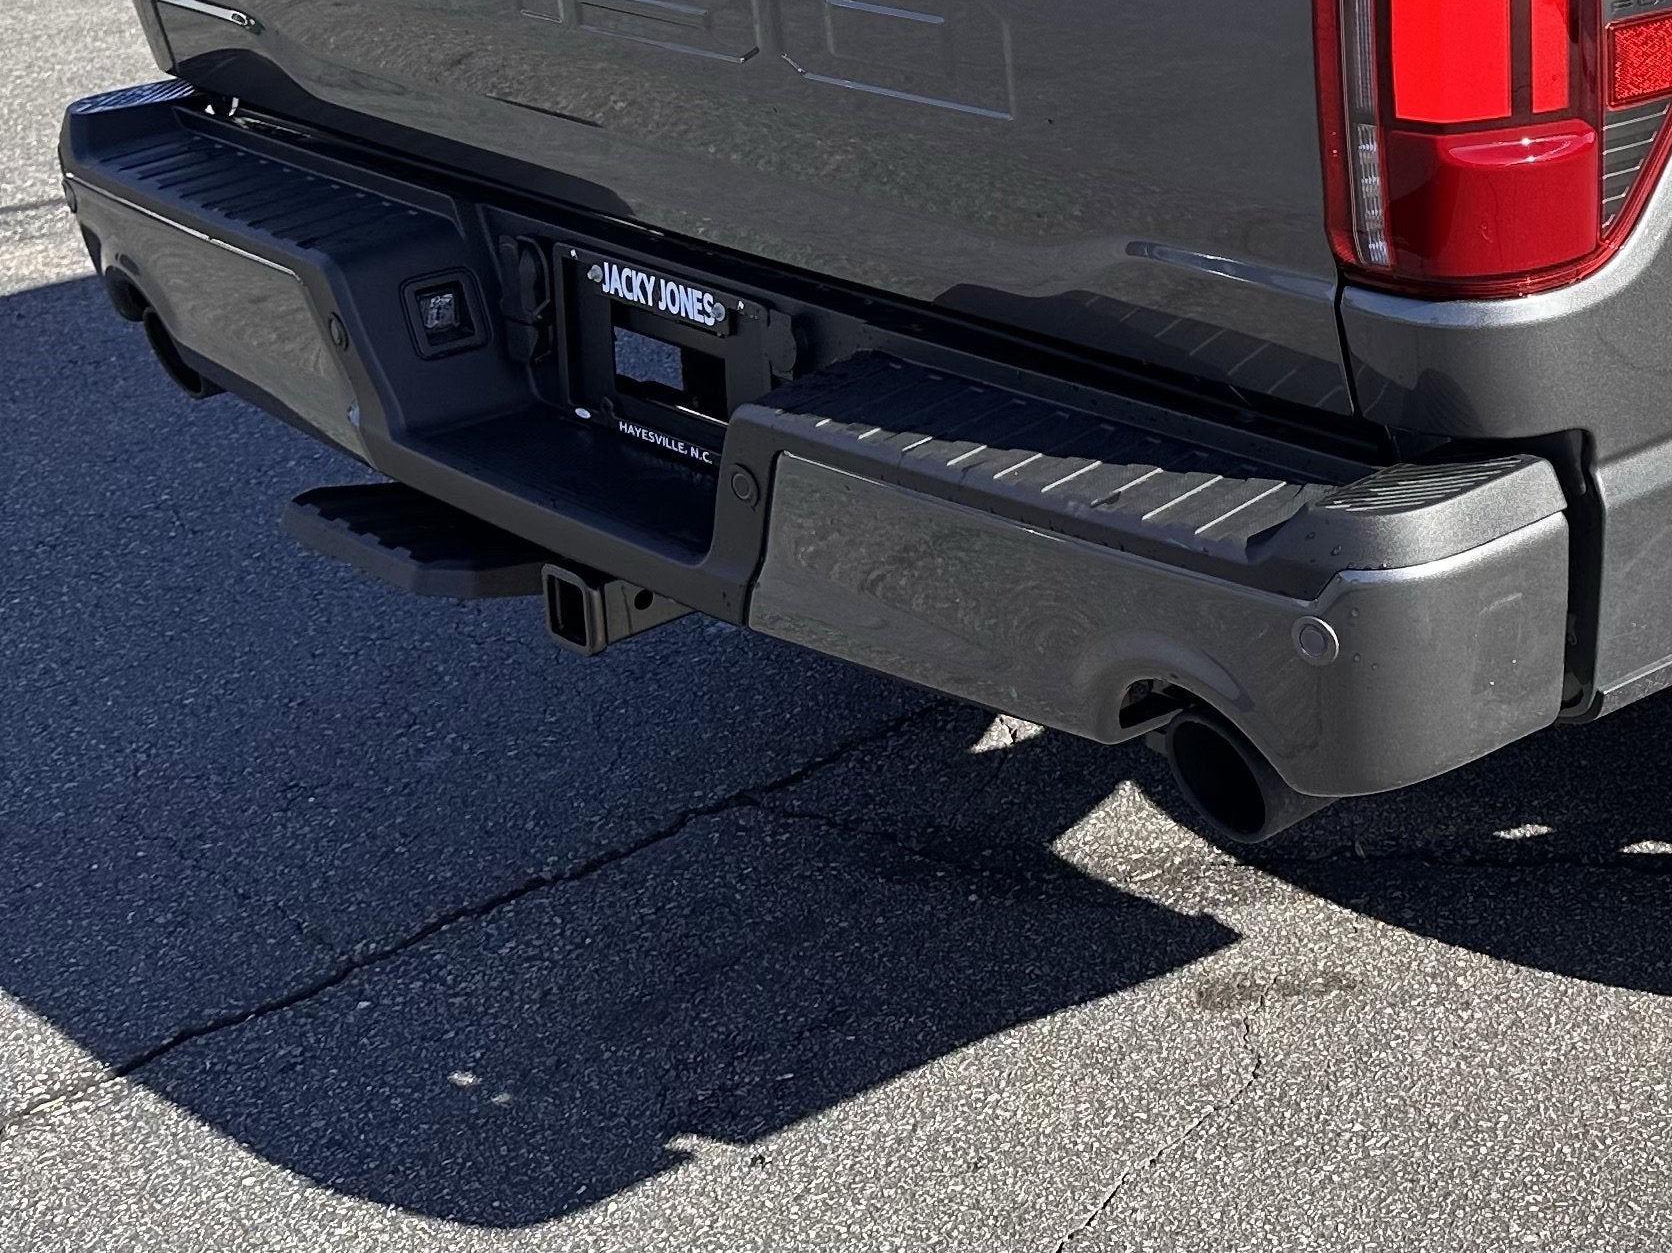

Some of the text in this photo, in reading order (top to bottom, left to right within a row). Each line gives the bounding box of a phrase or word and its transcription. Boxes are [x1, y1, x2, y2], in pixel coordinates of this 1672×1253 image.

[602, 260, 717, 327] JACKY JONES
[690, 446, 713, 465] N.C.
